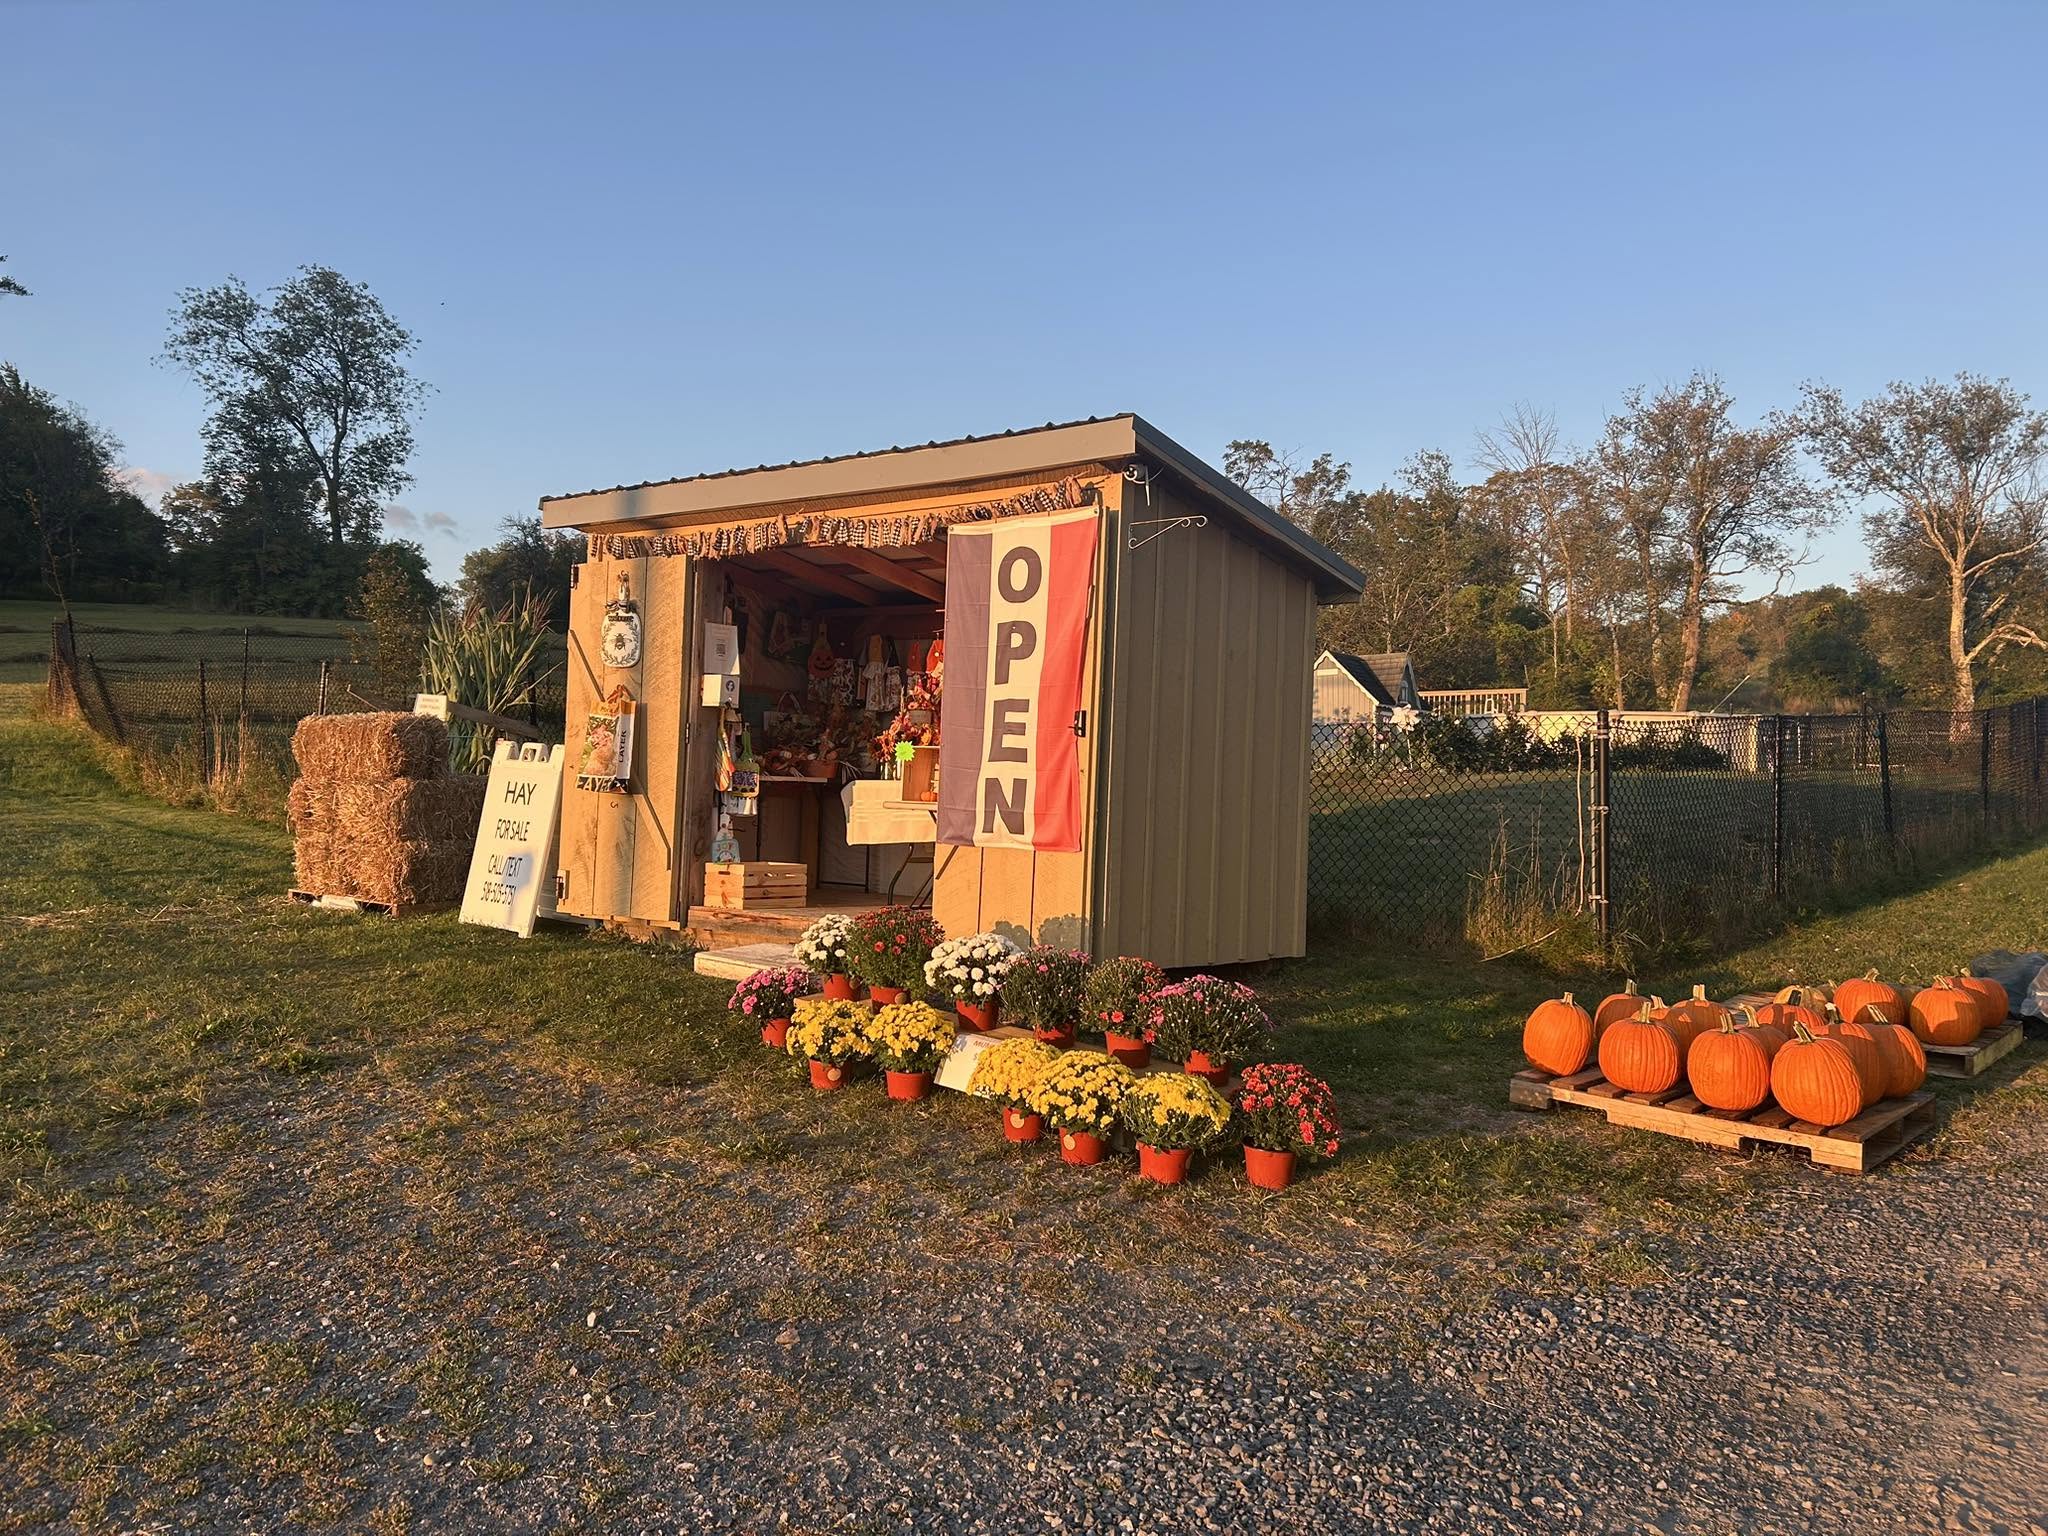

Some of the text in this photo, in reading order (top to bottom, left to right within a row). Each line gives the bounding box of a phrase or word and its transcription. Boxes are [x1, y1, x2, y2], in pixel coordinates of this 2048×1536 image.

[982, 546, 1042, 835] OPEN
[618, 730, 627, 763] LAYER
[505, 782, 537, 805] HAY
[495, 818, 530, 842] FOR SALE
